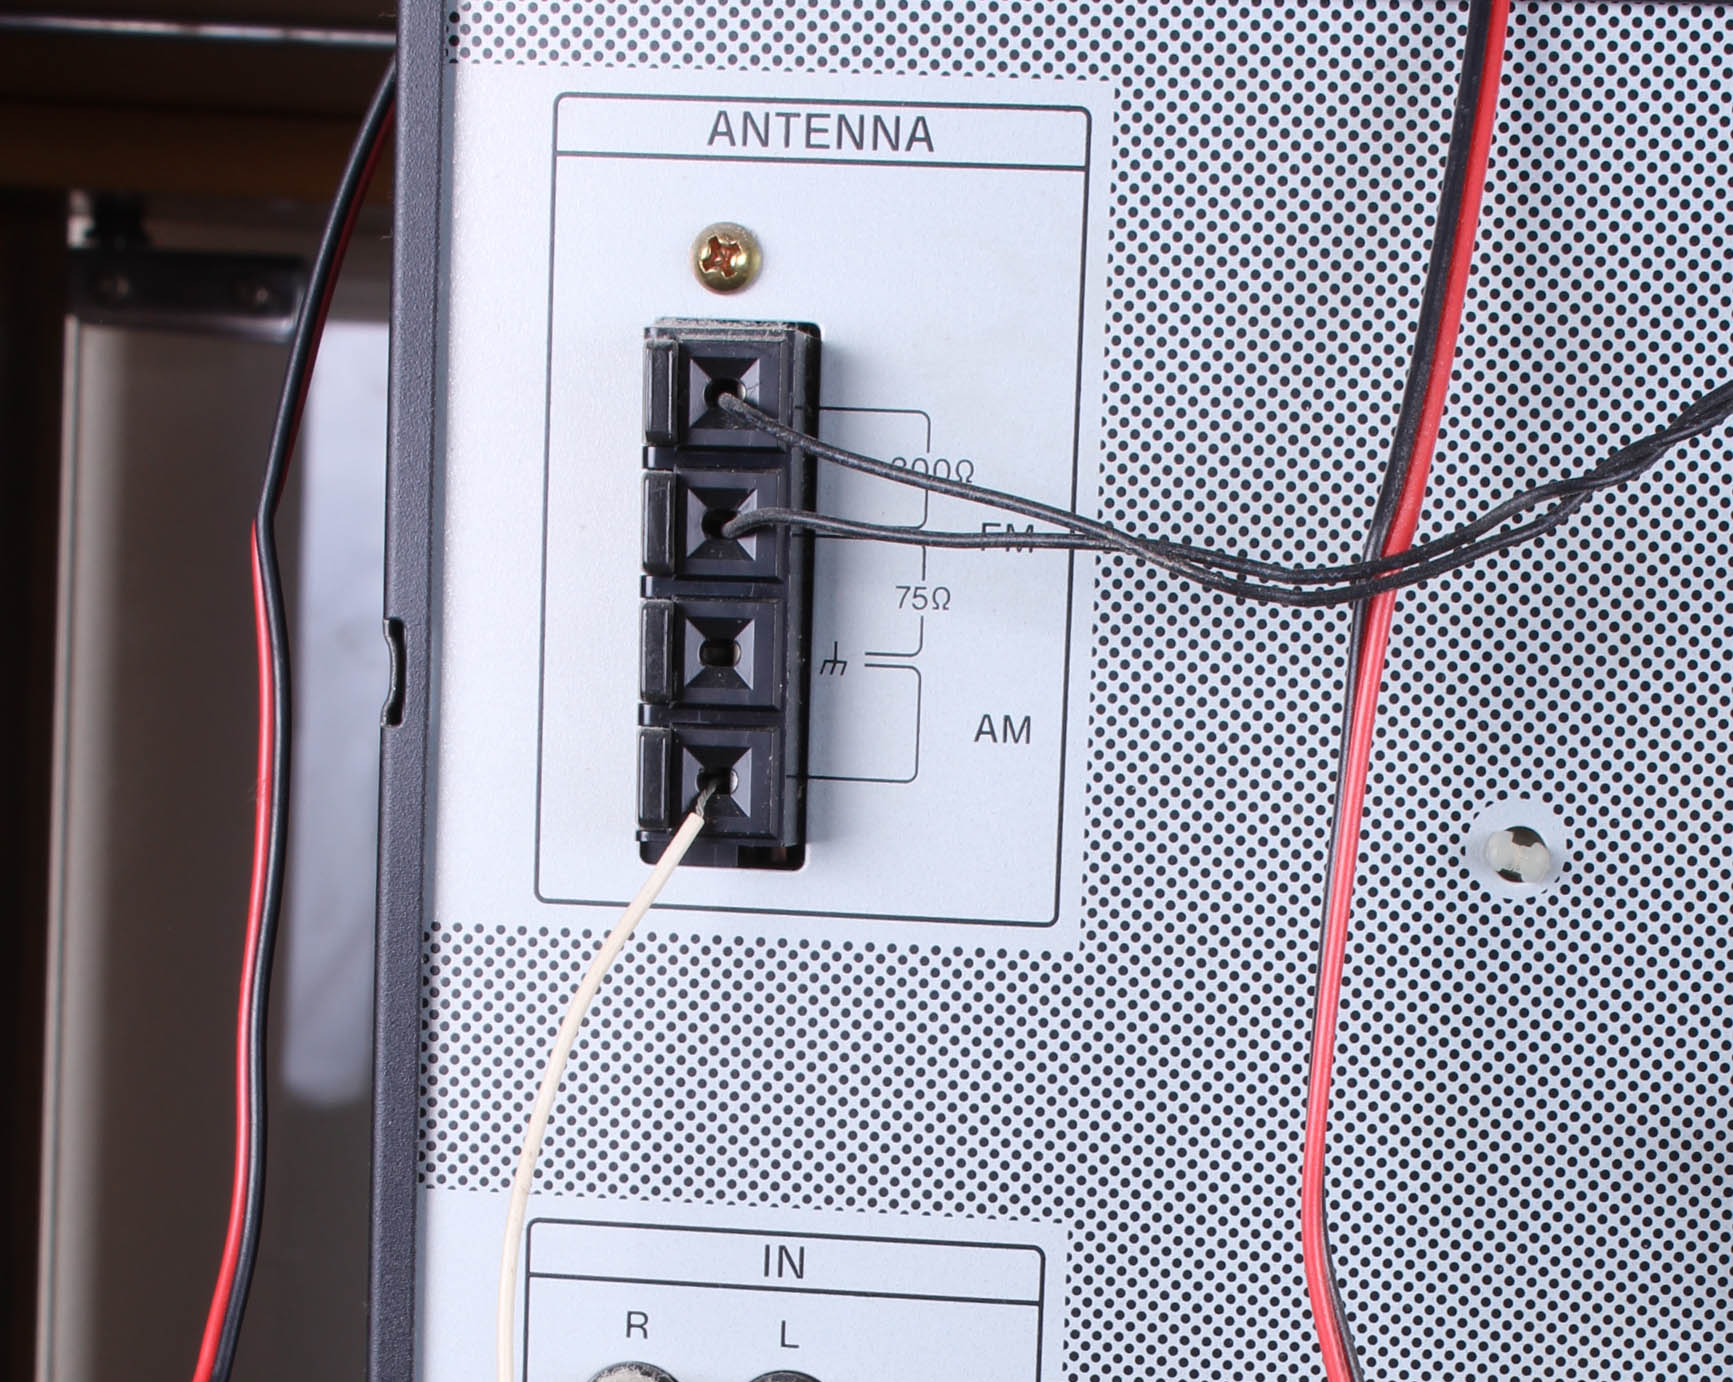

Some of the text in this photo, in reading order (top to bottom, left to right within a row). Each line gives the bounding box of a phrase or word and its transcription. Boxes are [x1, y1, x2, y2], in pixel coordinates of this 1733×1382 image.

[706, 109, 936, 153] ANTENNA
[896, 585, 951, 611] 75Ω
[974, 713, 1032, 744] AM
[763, 1244, 805, 1280] IN
[625, 1310, 650, 1339] R
[780, 1320, 800, 1348] L
